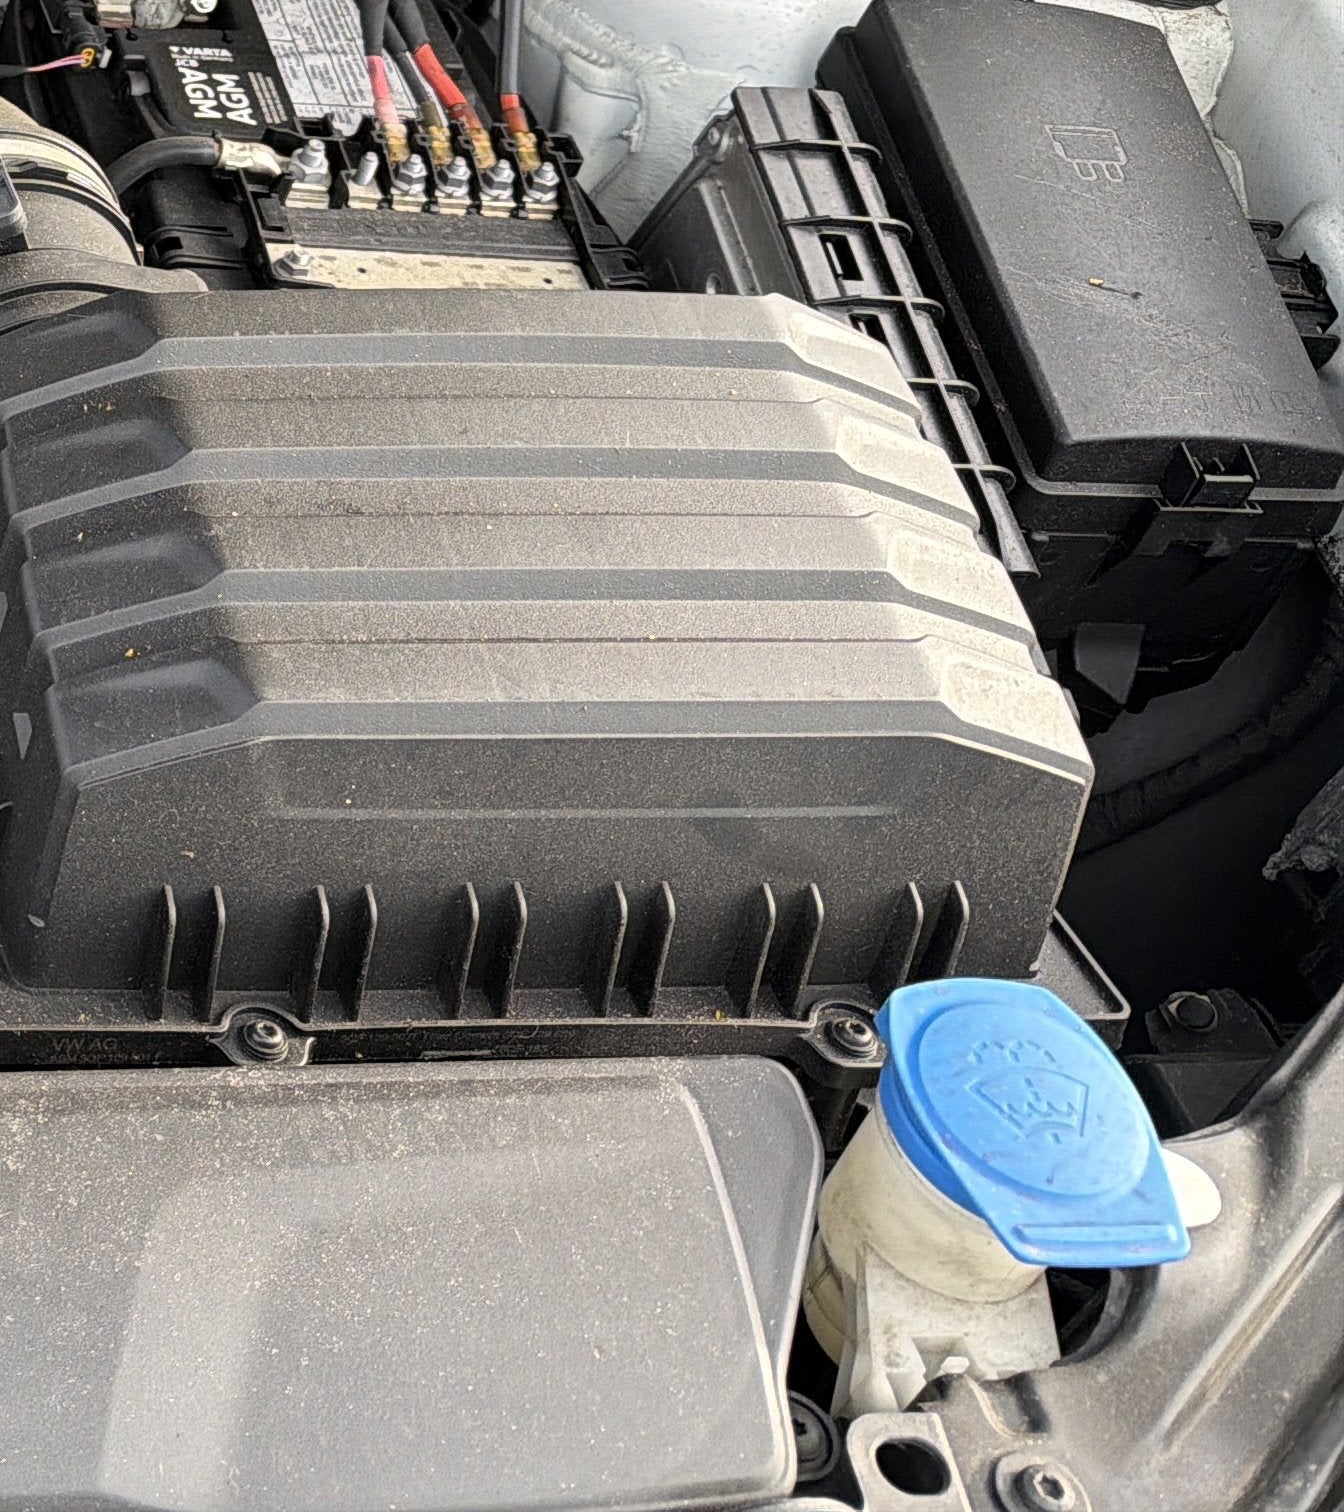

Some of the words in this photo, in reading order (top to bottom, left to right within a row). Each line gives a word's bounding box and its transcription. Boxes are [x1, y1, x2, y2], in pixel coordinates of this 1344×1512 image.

[181, 47, 233, 57] VARTA
[177, 66, 223, 119] AGM
[211, 73, 258, 126] AGM
